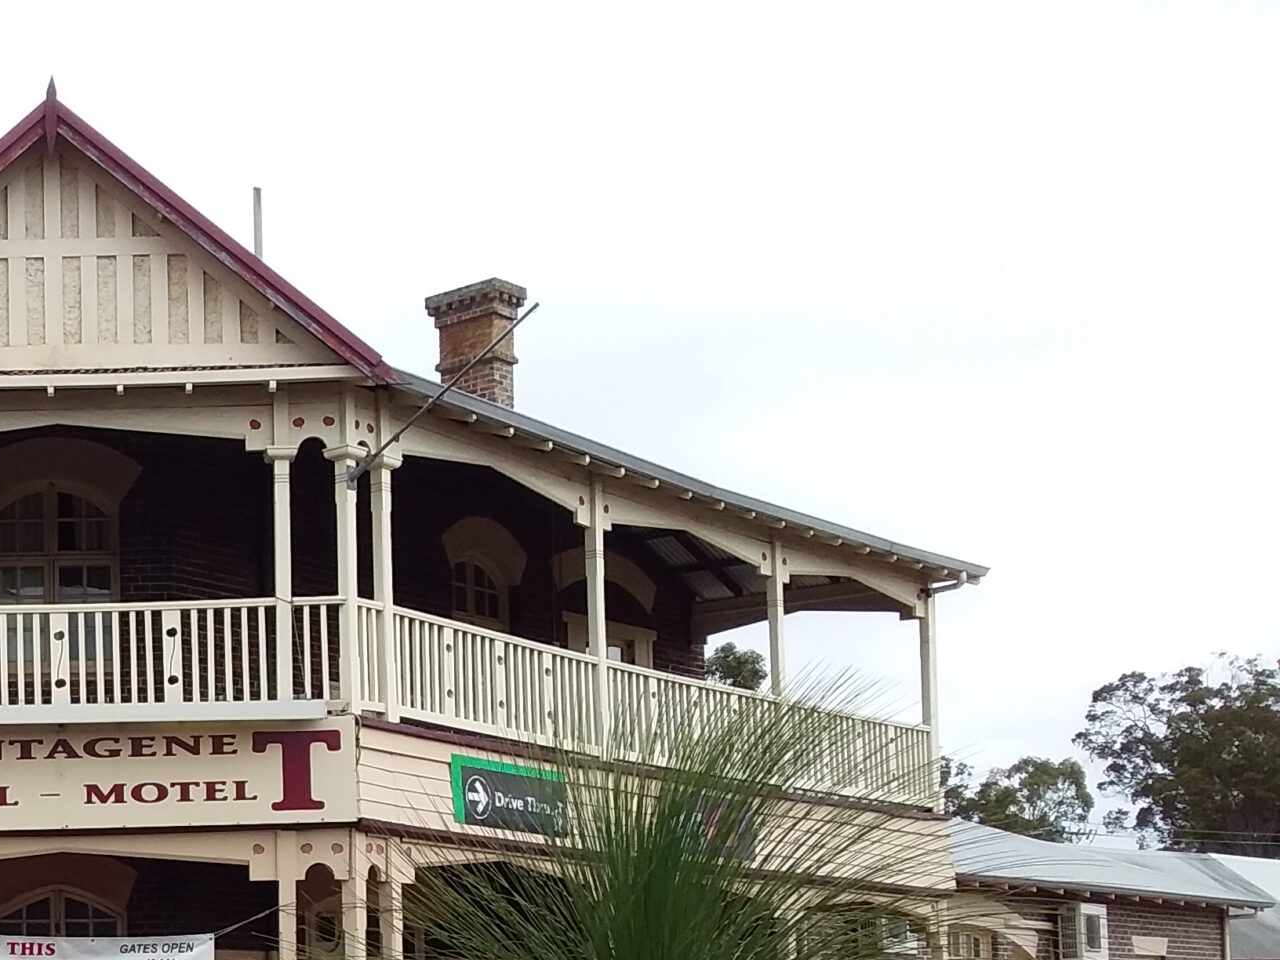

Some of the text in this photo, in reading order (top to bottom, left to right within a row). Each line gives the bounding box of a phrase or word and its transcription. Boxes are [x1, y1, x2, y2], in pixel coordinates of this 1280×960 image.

[83, 780, 258, 805] MOTEL
[494, 791, 524, 811] Drive
[6, 942, 56, 957] THIS
[120, 942, 195, 954] GATES OPEN
